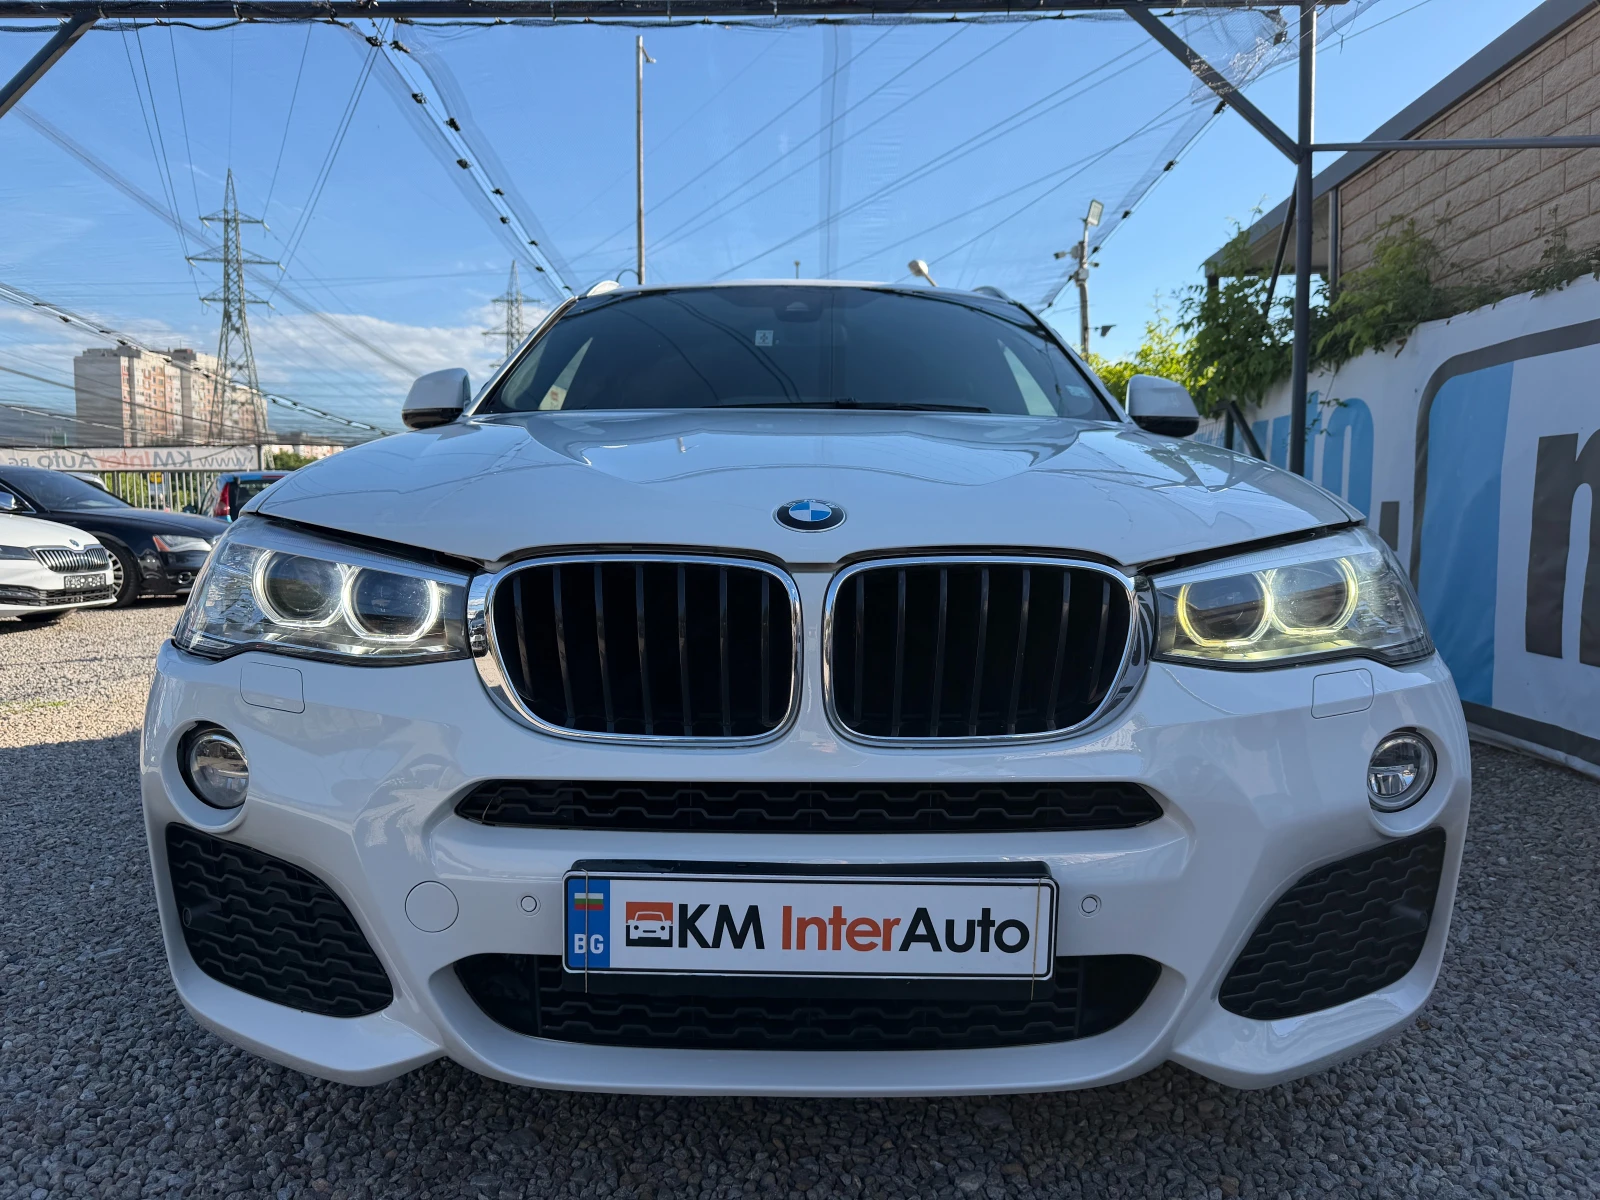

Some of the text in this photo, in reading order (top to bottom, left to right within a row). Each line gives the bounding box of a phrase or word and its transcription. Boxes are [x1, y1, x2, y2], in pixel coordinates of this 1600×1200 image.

[574, 933, 604, 954] BG
[678, 903, 1030, 953] KM InterAuto
